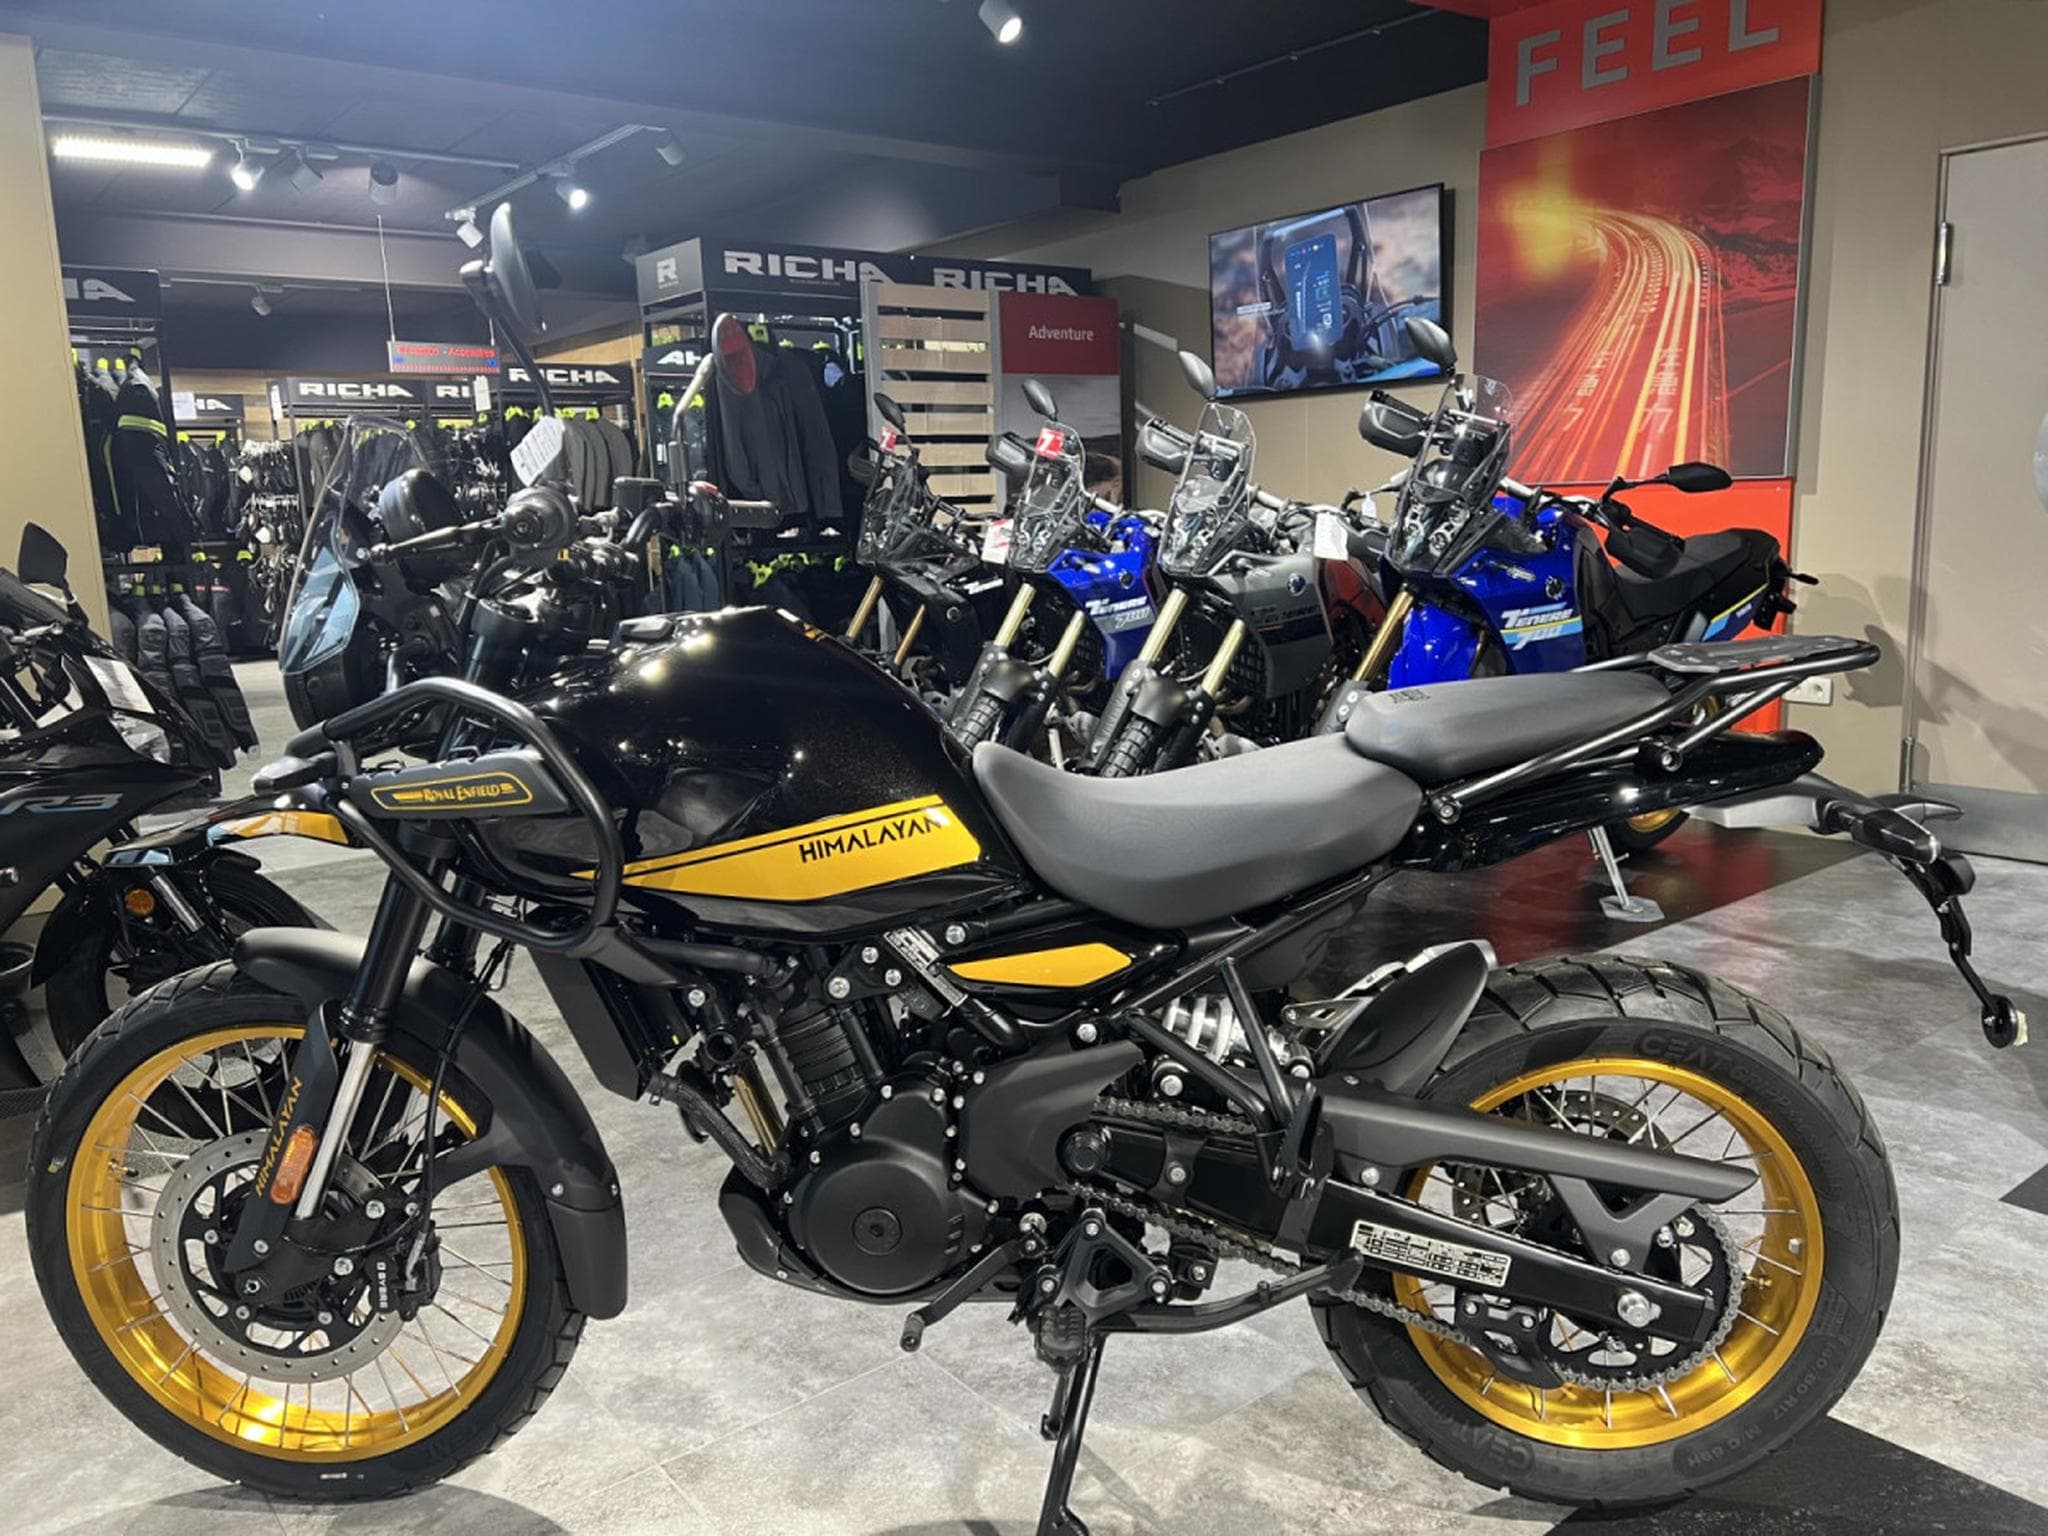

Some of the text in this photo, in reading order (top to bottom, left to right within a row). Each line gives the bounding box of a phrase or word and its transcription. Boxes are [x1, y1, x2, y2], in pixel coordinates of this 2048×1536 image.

[1516, 0, 1780, 107] FEEL
[656, 257, 679, 284] R
[724, 250, 898, 284] RICHA
[933, 267, 1079, 297] RICHA
[1028, 325, 1095, 342] Adventure
[299, 382, 413, 398] RICHA
[799, 815, 943, 864] HIMALAYAN
[255, 1076, 303, 1198] HIMALAYAN
